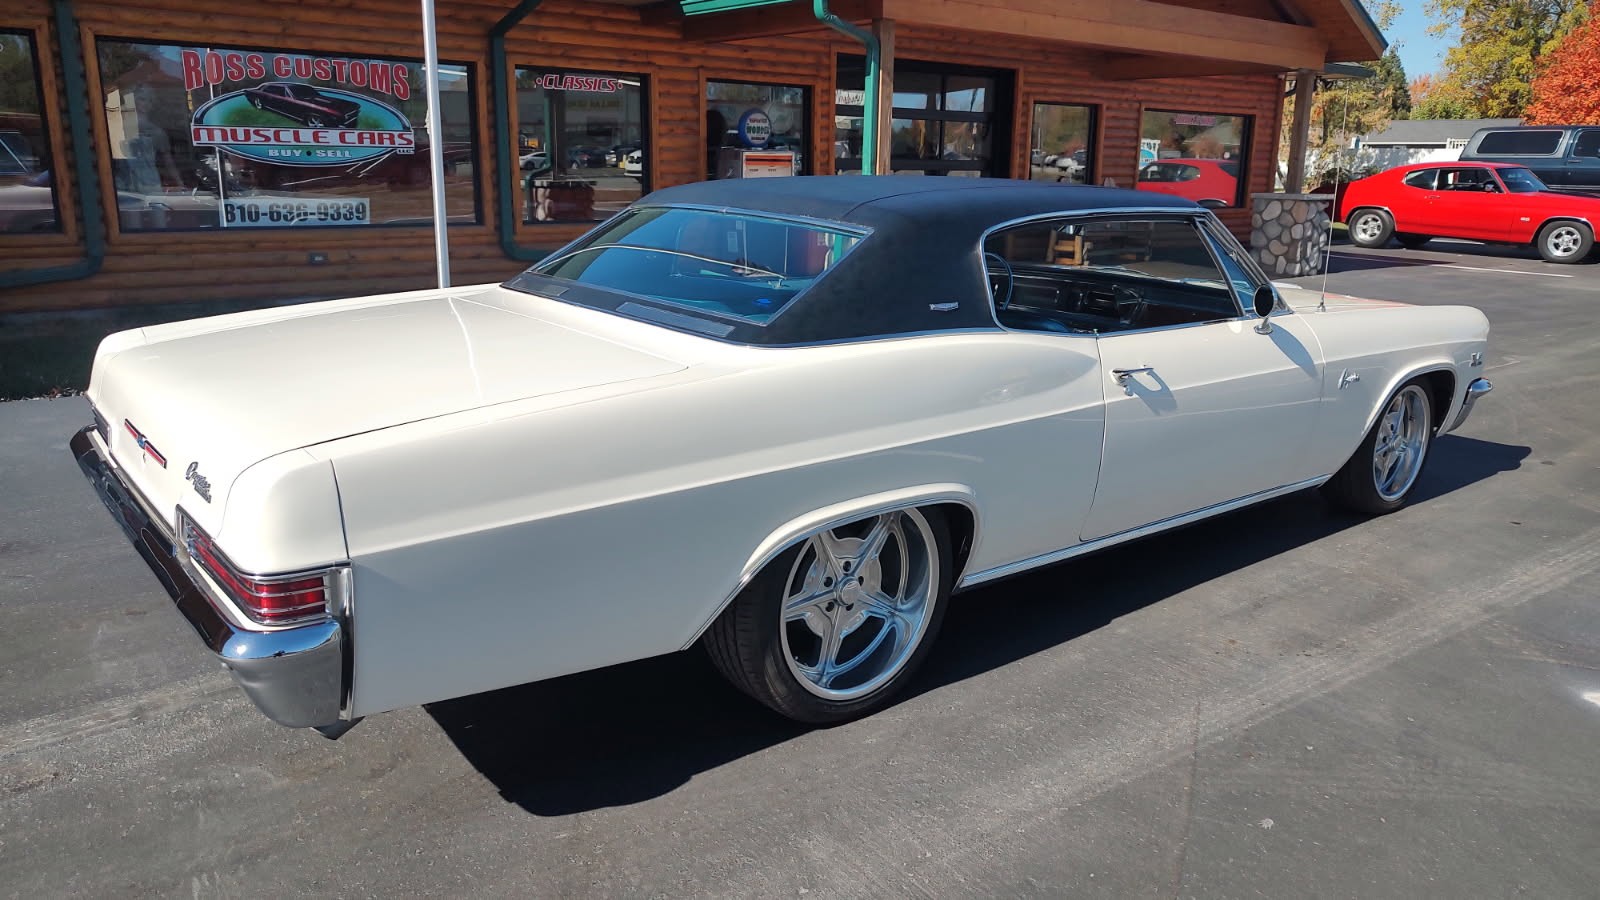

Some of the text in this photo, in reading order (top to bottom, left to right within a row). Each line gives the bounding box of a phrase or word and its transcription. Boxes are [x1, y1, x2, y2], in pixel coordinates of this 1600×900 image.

[182, 50, 410, 100] ROSS CUSTOMS
[543, 74, 617, 93] CLASSICS
[193, 127, 413, 146] MUSCLE CARS
[268, 149, 352, 158] BUY SELL
